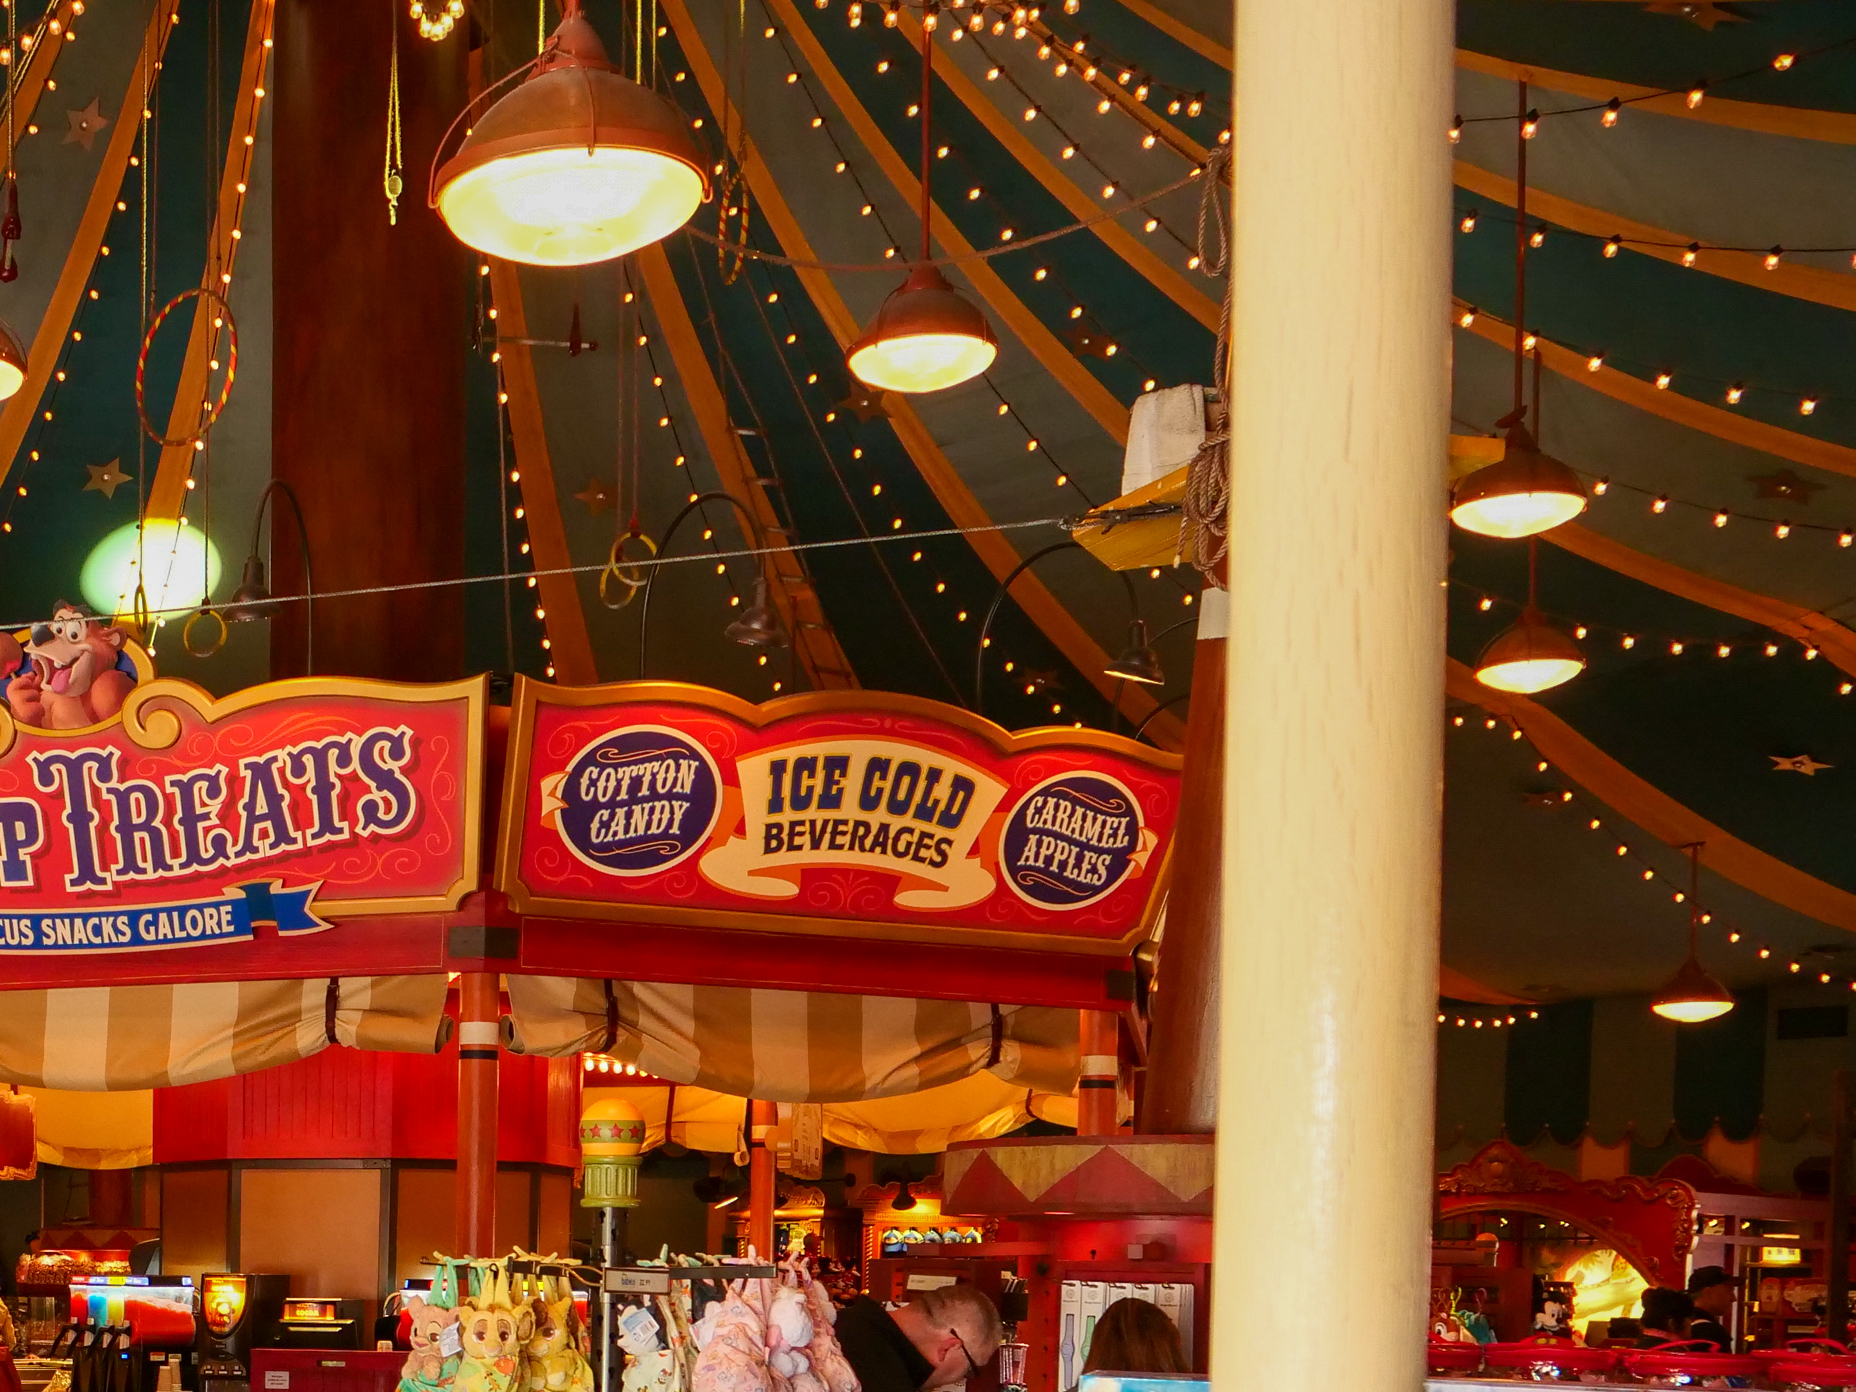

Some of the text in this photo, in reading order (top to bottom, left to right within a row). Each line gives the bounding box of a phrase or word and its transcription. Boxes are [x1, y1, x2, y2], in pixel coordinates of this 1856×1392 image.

[579, 758, 700, 802] COTTON
[764, 754, 977, 832] ICE COLD
[28, 724, 417, 892] TREATS
[590, 799, 691, 844] CANDY
[1024, 795, 1130, 849] CARAMEL
[761, 815, 954, 869] BEVERAGES
[1015, 832, 1113, 886] APPLES
[41, 910, 132, 945] SNACKS
[138, 903, 235, 940] GALORE
